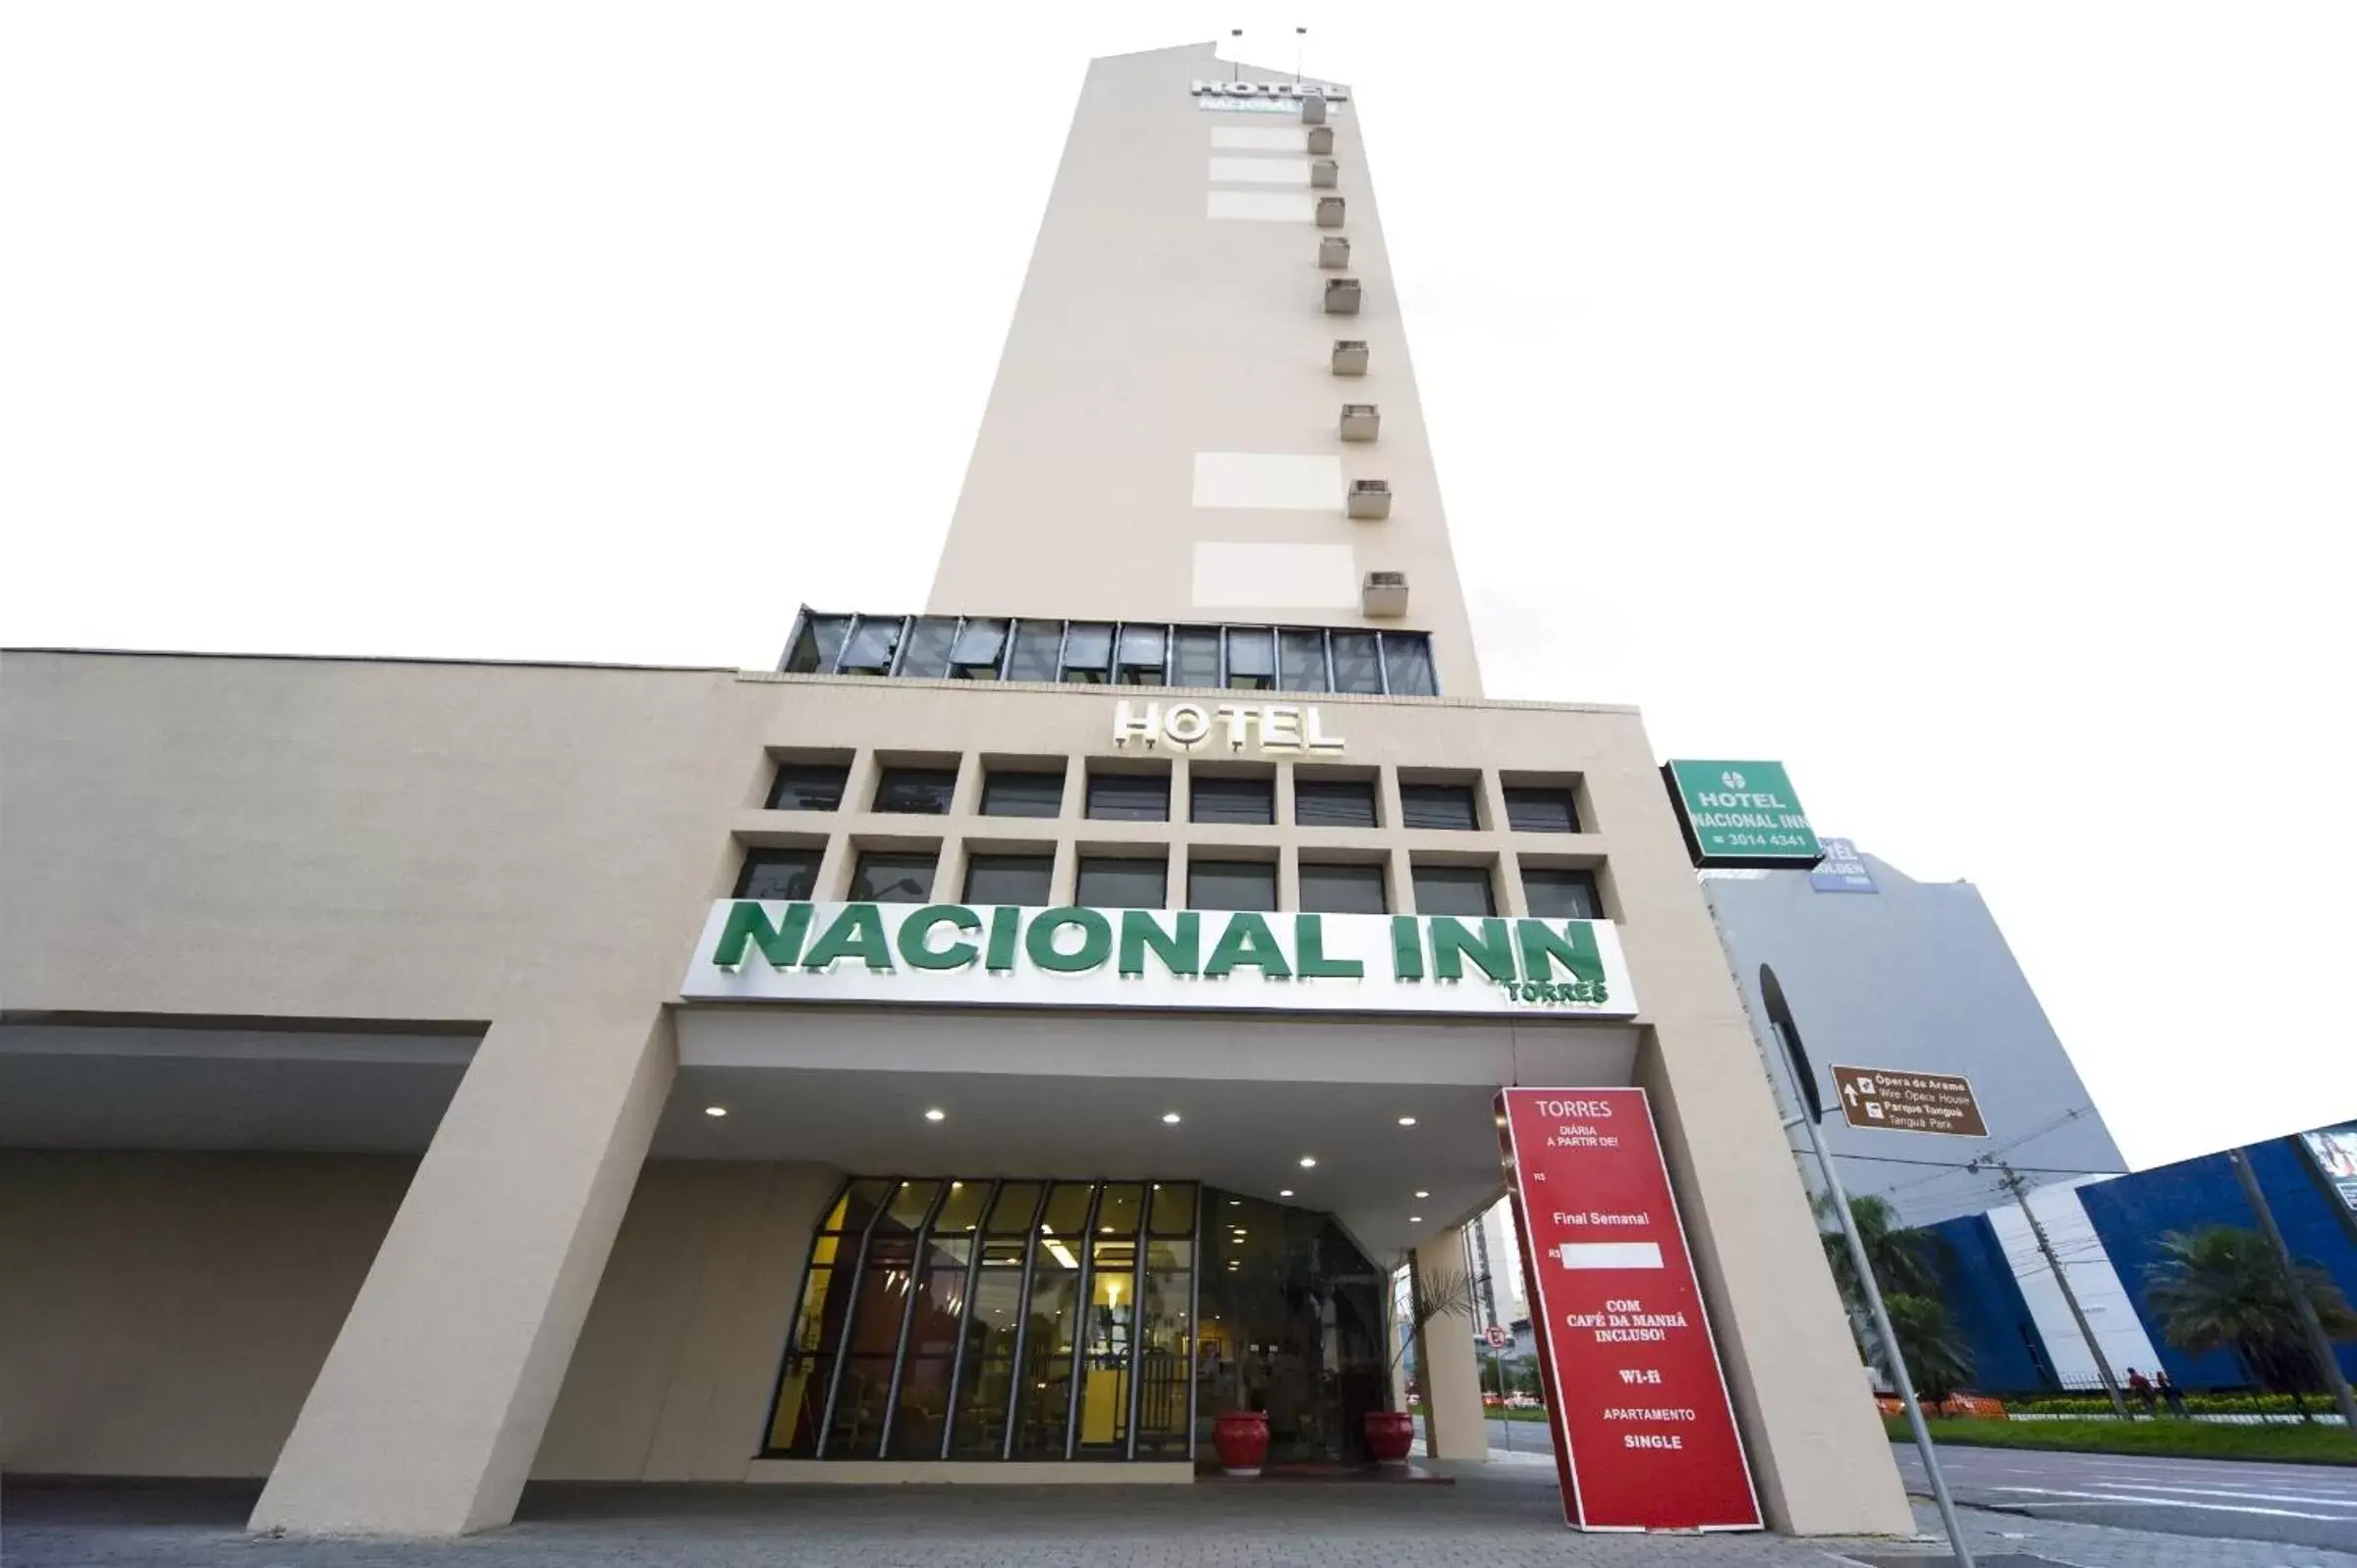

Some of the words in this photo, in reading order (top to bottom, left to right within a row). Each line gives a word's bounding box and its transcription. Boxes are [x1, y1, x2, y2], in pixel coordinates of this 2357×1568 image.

[1191, 81, 1347, 101] HOTEL
[1114, 700, 1345, 753] HOTEL
[1698, 791, 1786, 809] HOTEL
[1691, 813, 1779, 829] NACIONAL
[1781, 815, 1812, 830] INN
[1728, 834, 1766, 846] 3014
[1770, 835, 1806, 846] 4341
[713, 901, 1364, 981] NACIONAL
[1391, 914, 1606, 983] INN
[1507, 982, 1609, 1003] TORRES
[1912, 1078, 1927, 1088] de
[1929, 1081, 1965, 1092] Arame
[1939, 1093, 1970, 1106] House
[1535, 1100, 1613, 1117] TORRES
[1884, 1101, 1923, 1114] Parque
[1560, 1124, 1597, 1136] DIÁRIA
[1929, 1118, 1953, 1129] Park
[1547, 1138, 1556, 1147] A
[1558, 1137, 1598, 1147] PARTIR
[1534, 1173, 1546, 1182] R$
[1554, 1212, 1588, 1225] Final
[1606, 1300, 1642, 1313] COM
[1566, 1312, 1608, 1327] CAFÉ
[1610, 1316, 1631, 1327] DA
[1595, 1329, 1667, 1343] INCLUSO!
[1603, 1409, 1696, 1422] APARTAMENTO
[1623, 1435, 1683, 1449] SINGLE
